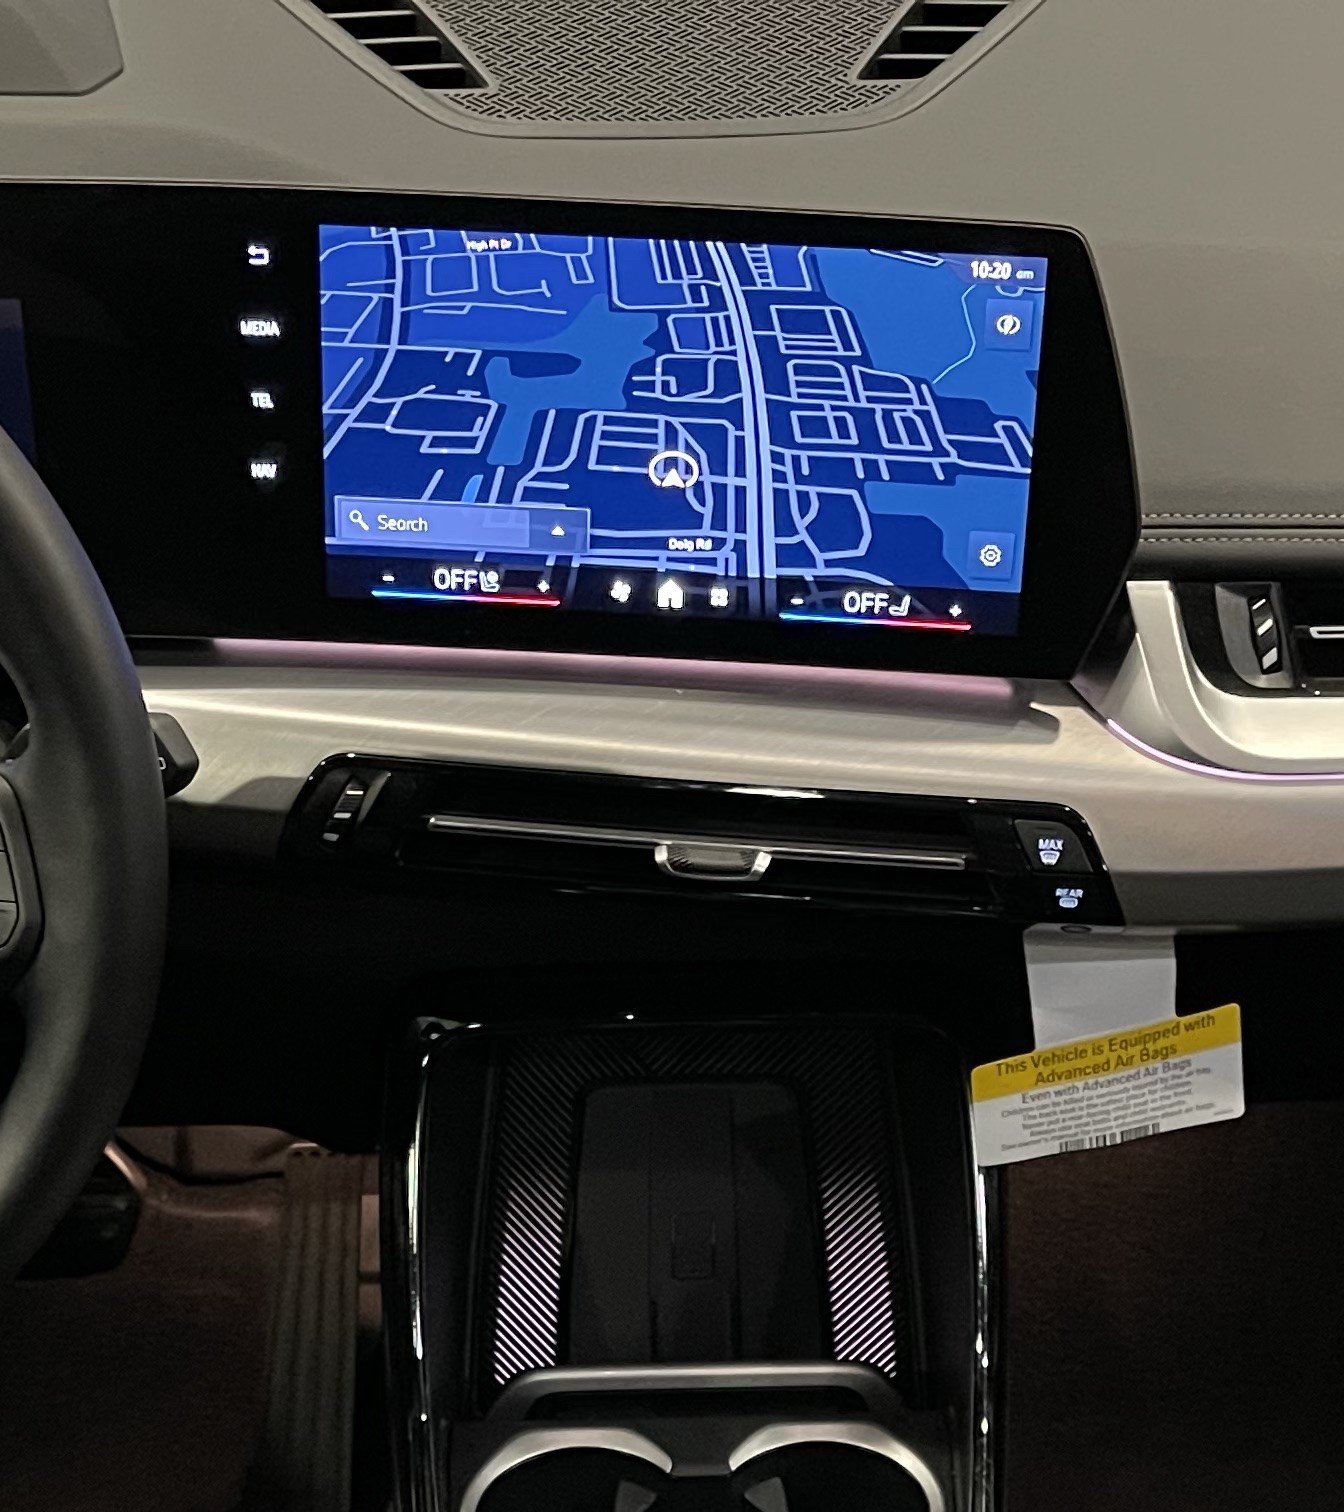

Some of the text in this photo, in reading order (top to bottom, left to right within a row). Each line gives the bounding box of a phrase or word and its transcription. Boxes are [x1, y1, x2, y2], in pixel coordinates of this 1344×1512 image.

[970, 260, 1035, 280] 10:20 am
[240, 320, 281, 337] MEDIA
[251, 392, 275, 409] TEL
[251, 463, 277, 479] NAV
[377, 514, 428, 533] Search
[433, 568, 478, 591] OFF
[843, 591, 890, 615] OFF
[1038, 838, 1064, 851] MAX
[1056, 888, 1084, 898] REAR
[996, 1014, 1216, 1077] This Vehicle is Equipped with
[1034, 1042, 1177, 1085] Advanced Air Bags
[1082, 1068, 1141, 1092] Advanced
